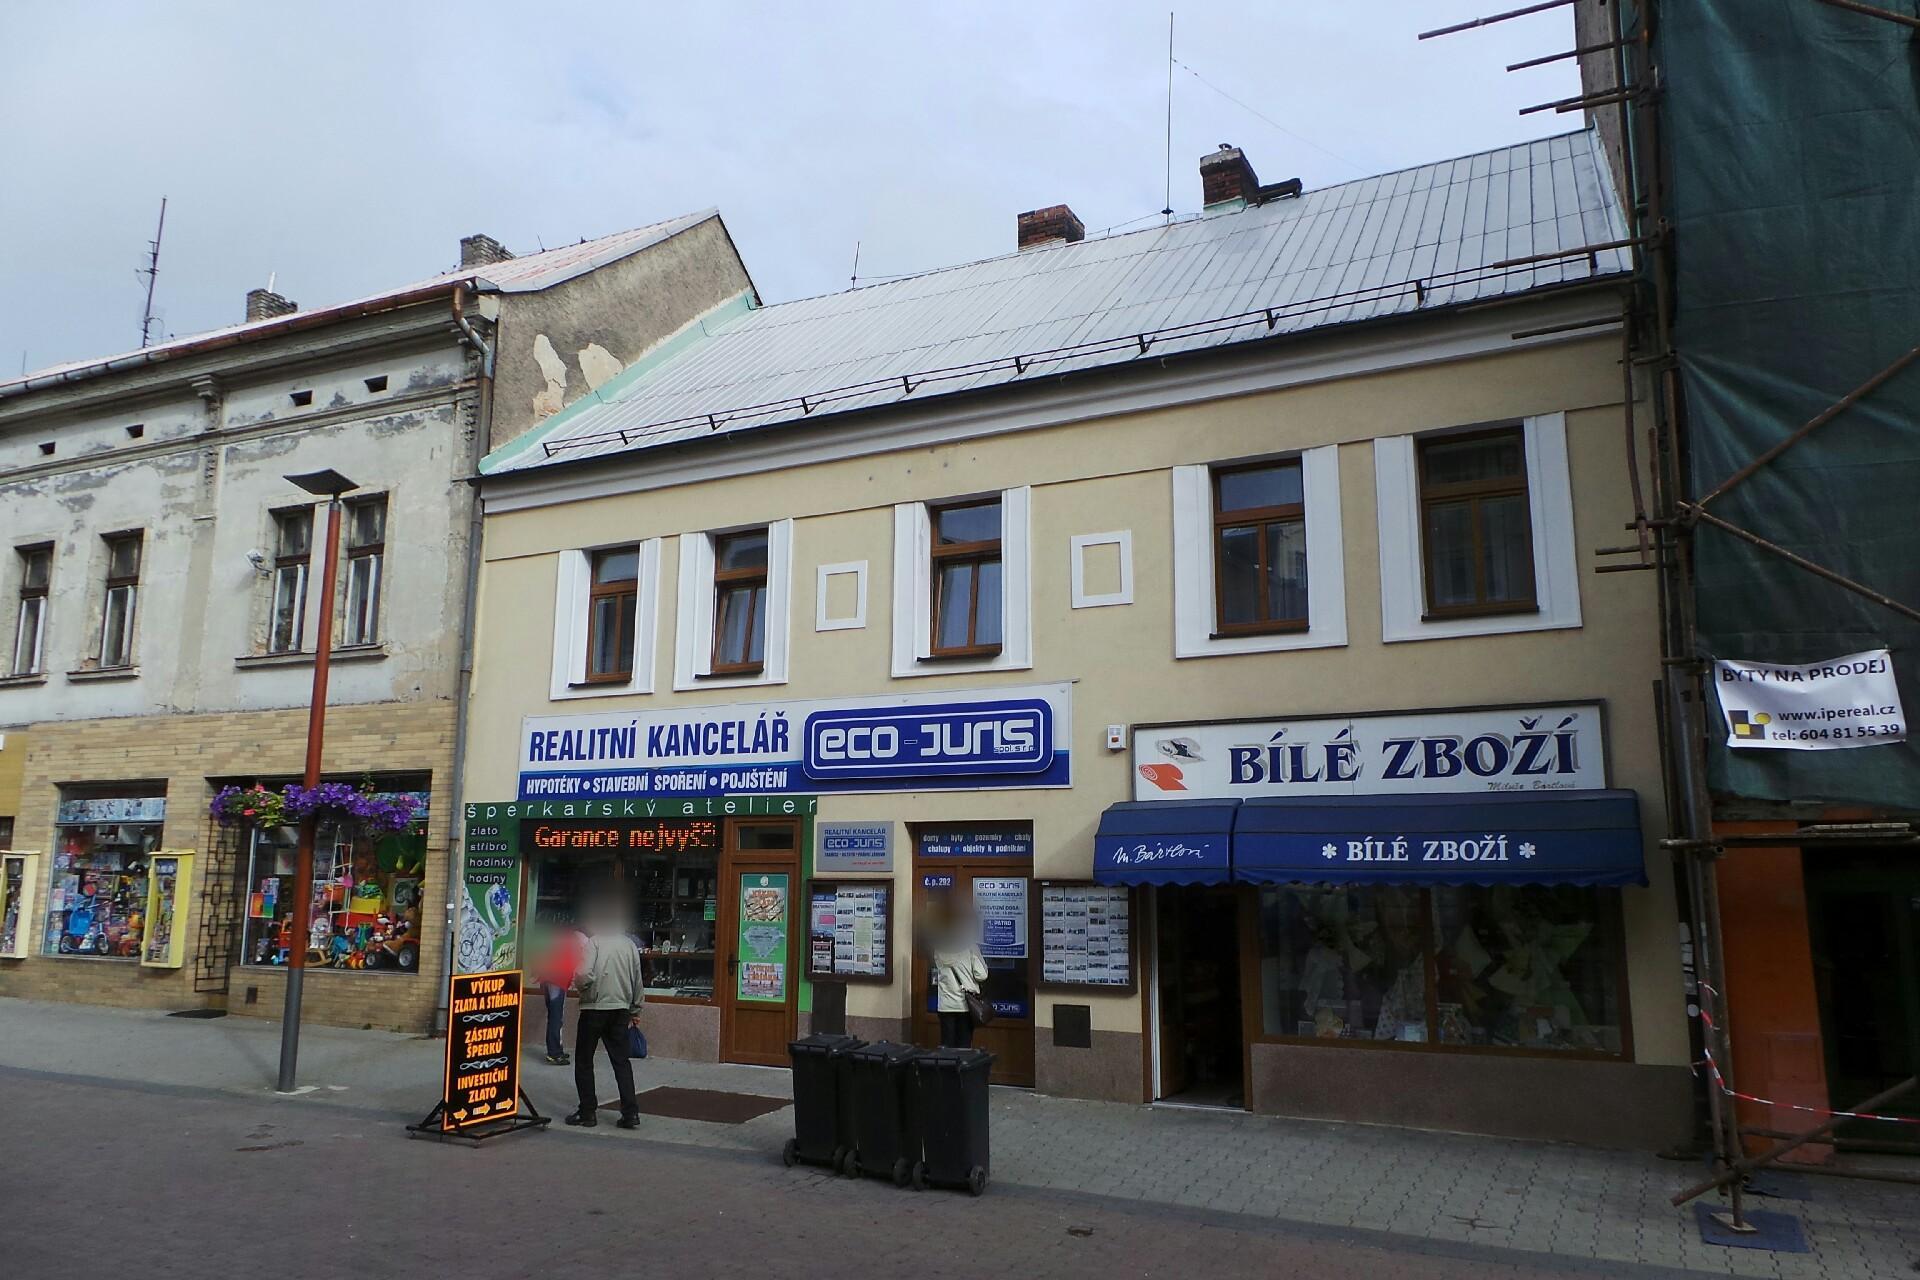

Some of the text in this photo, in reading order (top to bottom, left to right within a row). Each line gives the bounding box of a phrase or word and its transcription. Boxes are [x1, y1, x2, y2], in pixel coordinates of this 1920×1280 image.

[1722, 659, 1886, 682] BYTY NA PRODEJ
[1778, 704, 1896, 722] www.ipereal.cz
[529, 711, 789, 762] REALITNÍ KANCELÁŘ
[1771, 723, 1900, 740] tel: 604 81 55 39
[1228, 712, 1582, 785] BÍLÉ ZBOŽÍ
[526, 767, 788, 794] HYPOTÉKY STAVEBNÍ SPOŘENÍ POJIŠTĚNÍ
[467, 797, 817, 819] šperkařský atelier
[471, 827, 498, 836] zlato
[534, 825, 619, 848] Garance
[928, 844, 951, 853] chalupy
[962, 844, 985, 854] objekty
[995, 844, 1026, 853] podnikání
[1347, 834, 1509, 861] BÍLÉ ZBOŽÍ
[469, 857, 514, 869] hodinky
[468, 873, 506, 885] hodiny
[471, 978, 505, 994] VÝKUP
[454, 991, 519, 1013] ZLATA A STŘÍBRA
[465, 1026, 505, 1044] ZÁSTAVY
[466, 1041, 503, 1059] ŠPERKŮ
[457, 1065, 509, 1090] INVESTIČNÍ
[468, 1086, 497, 1104] ZLATO
